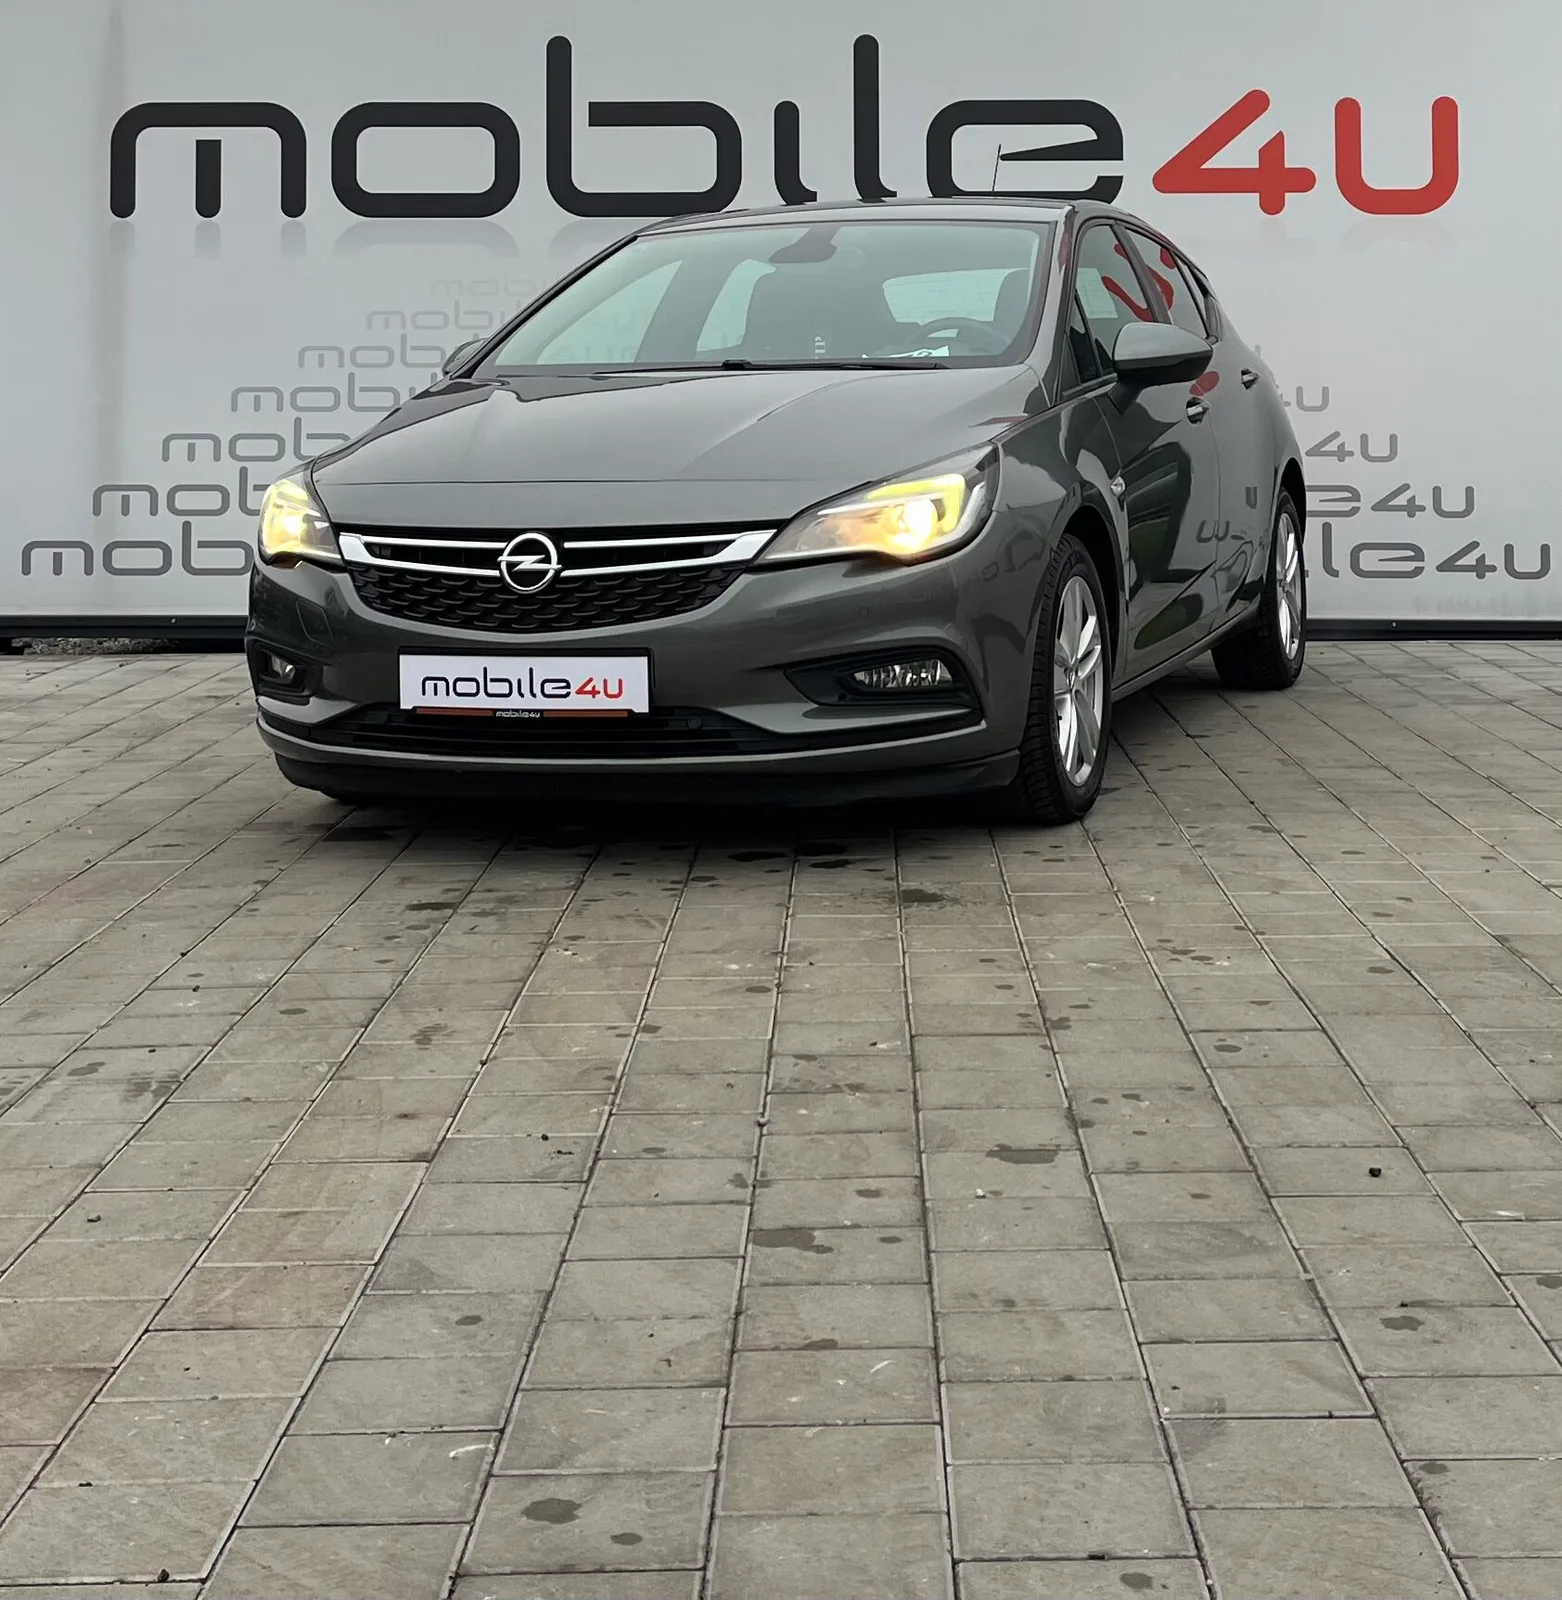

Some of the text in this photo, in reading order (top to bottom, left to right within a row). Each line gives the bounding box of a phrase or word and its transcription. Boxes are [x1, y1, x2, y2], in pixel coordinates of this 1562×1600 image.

[109, 34, 1460, 219] mobile4u
[21, 520, 253, 577] mob
[1305, 521, 1551, 580] le4u
[421, 666, 624, 699] mobile4u
